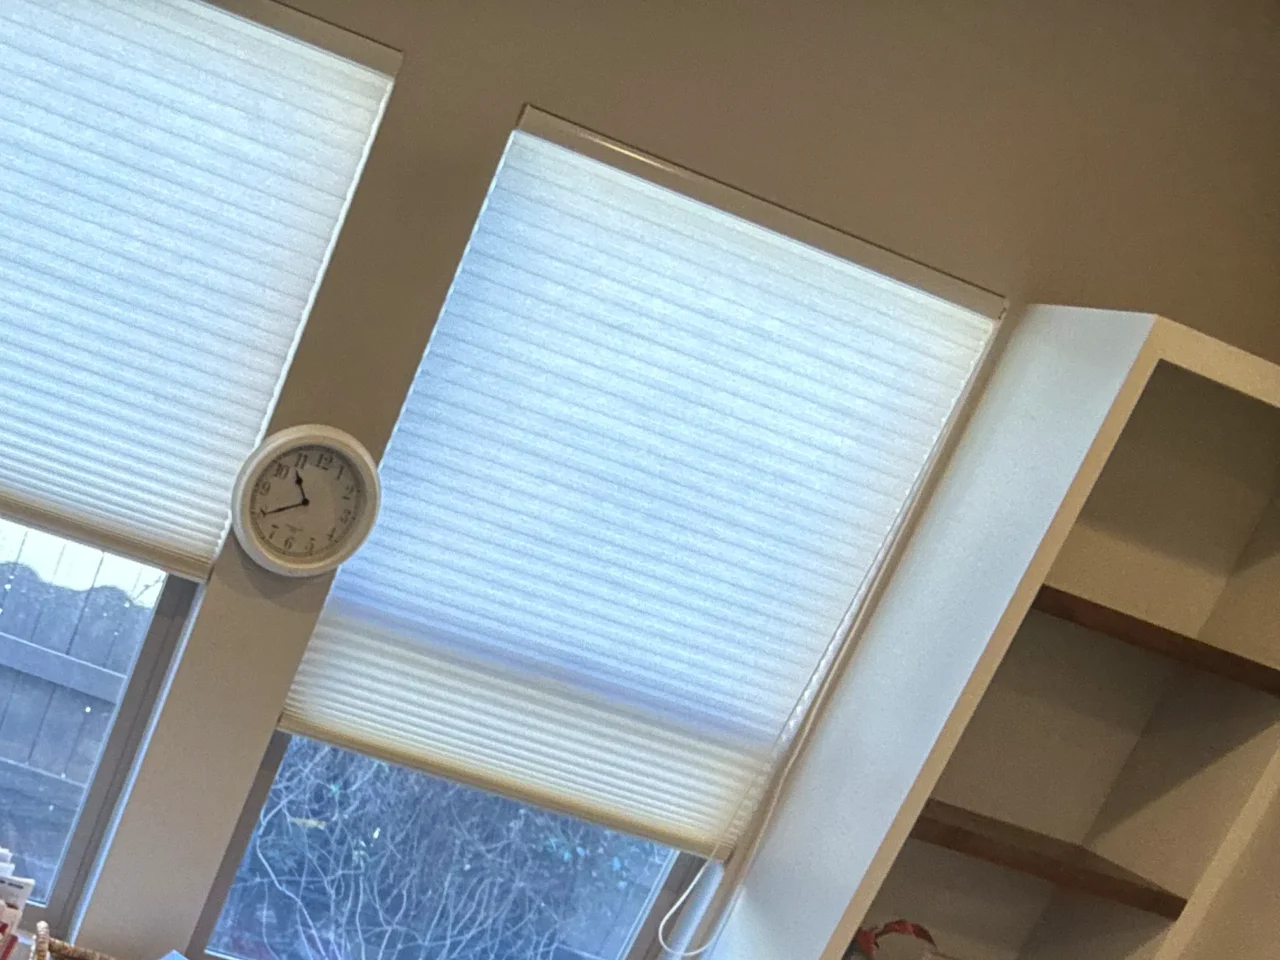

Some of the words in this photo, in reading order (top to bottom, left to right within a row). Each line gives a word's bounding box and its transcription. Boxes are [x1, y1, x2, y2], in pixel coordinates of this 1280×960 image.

[294, 453, 308, 470] 11
[315, 453, 333, 471] 12
[274, 463, 290, 480] 10
[259, 481, 270, 496] 9
[342, 485, 355, 500] 2
[269, 524, 279, 539] 7
[284, 535, 295, 549] 6
